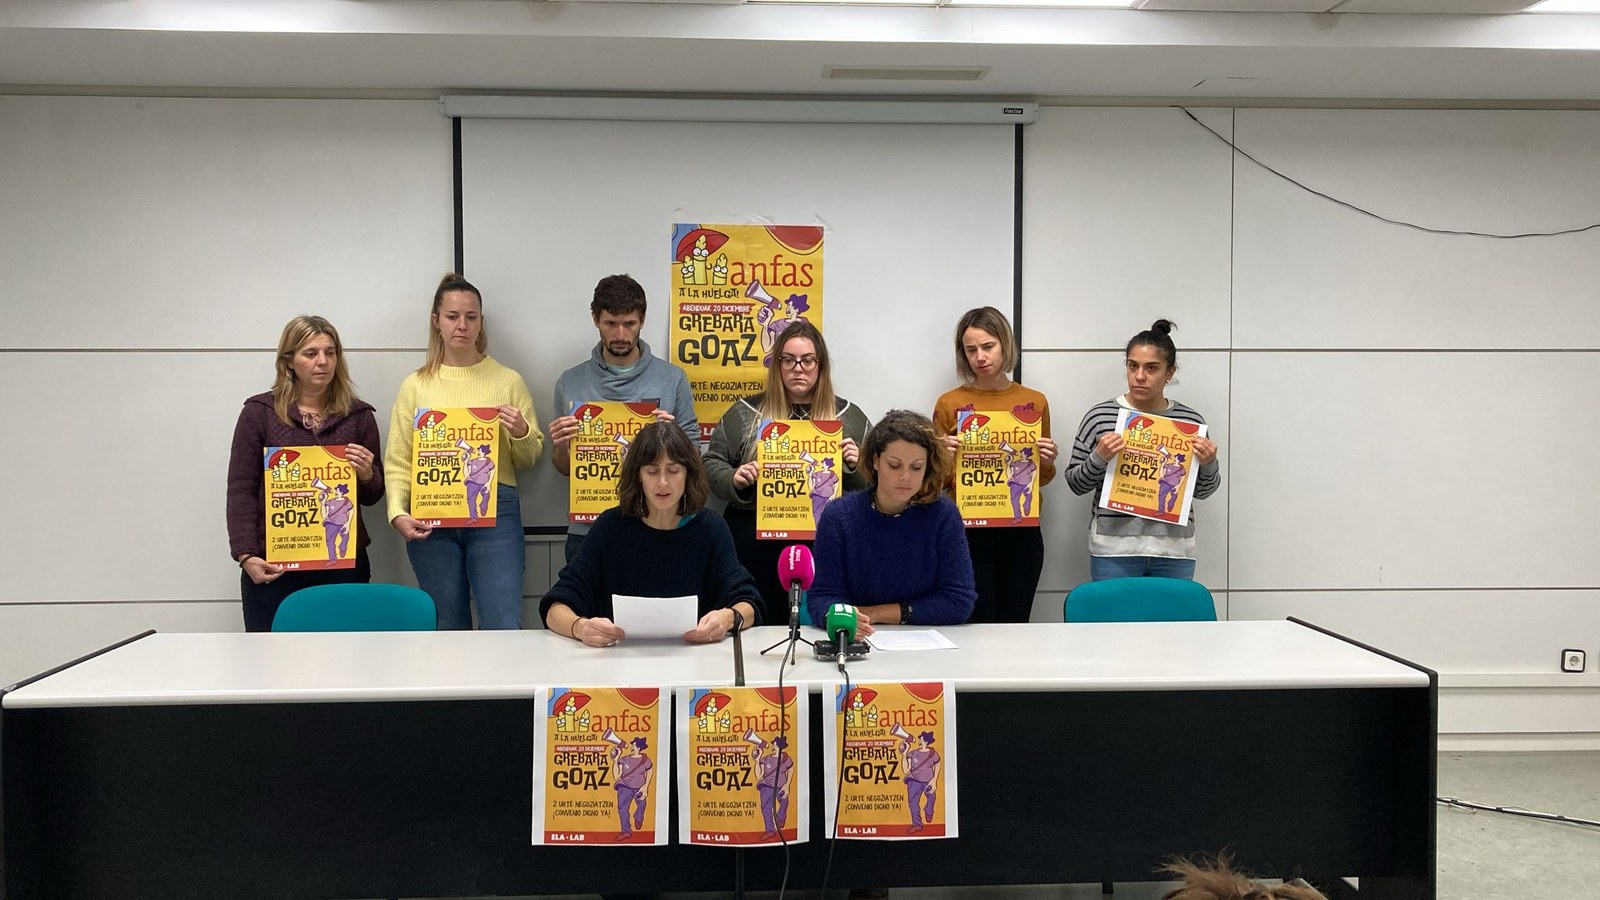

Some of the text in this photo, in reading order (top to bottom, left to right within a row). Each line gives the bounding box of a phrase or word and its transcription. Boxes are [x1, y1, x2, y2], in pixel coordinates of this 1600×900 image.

[731, 254, 813, 288] anfas
[679, 288, 739, 299] A LA HUELGA!
[680, 313, 755, 333] GREBARA
[678, 333, 758, 366] GOAZ
[711, 382, 763, 391] NEGOZIATZEN
[447, 423, 494, 441] anfas
[991, 427, 1036, 445] anfas
[791, 435, 837, 454] anfas
[1150, 433, 1191, 452] anfas
[418, 455, 460, 468] GREBARA
[576, 450, 619, 462] GREBARA
[962, 458, 1003, 469] GREBARA
[1123, 452, 1158, 467] GREBARA
[302, 462, 351, 481] anfas
[417, 467, 461, 486] GOAZ
[575, 462, 620, 481] GOAZ
[763, 468, 805, 480] GREBARA
[961, 468, 1005, 487] GOAZ
[1120, 464, 1158, 481] GOAZ
[762, 480, 806, 498] GOAZ
[272, 497, 317, 509] GREBARA
[271, 508, 319, 528] GOAZ
[592, 709, 651, 733] anfas
[732, 709, 790, 733] anfas
[880, 704, 938, 727] anfas
[560, 734, 569, 742] LA
[554, 752, 608, 766] GREBARA
[697, 753, 750, 767] GREBARA
[845, 747, 897, 761] GREBARA
[553, 767, 610, 790] GOAZ
[696, 767, 752, 791] GOAZ
[844, 761, 900, 784] GOAZ
[601, 810, 610, 818] YA!
[744, 810, 754, 818] YA!
[892, 803, 902, 812] YA!
